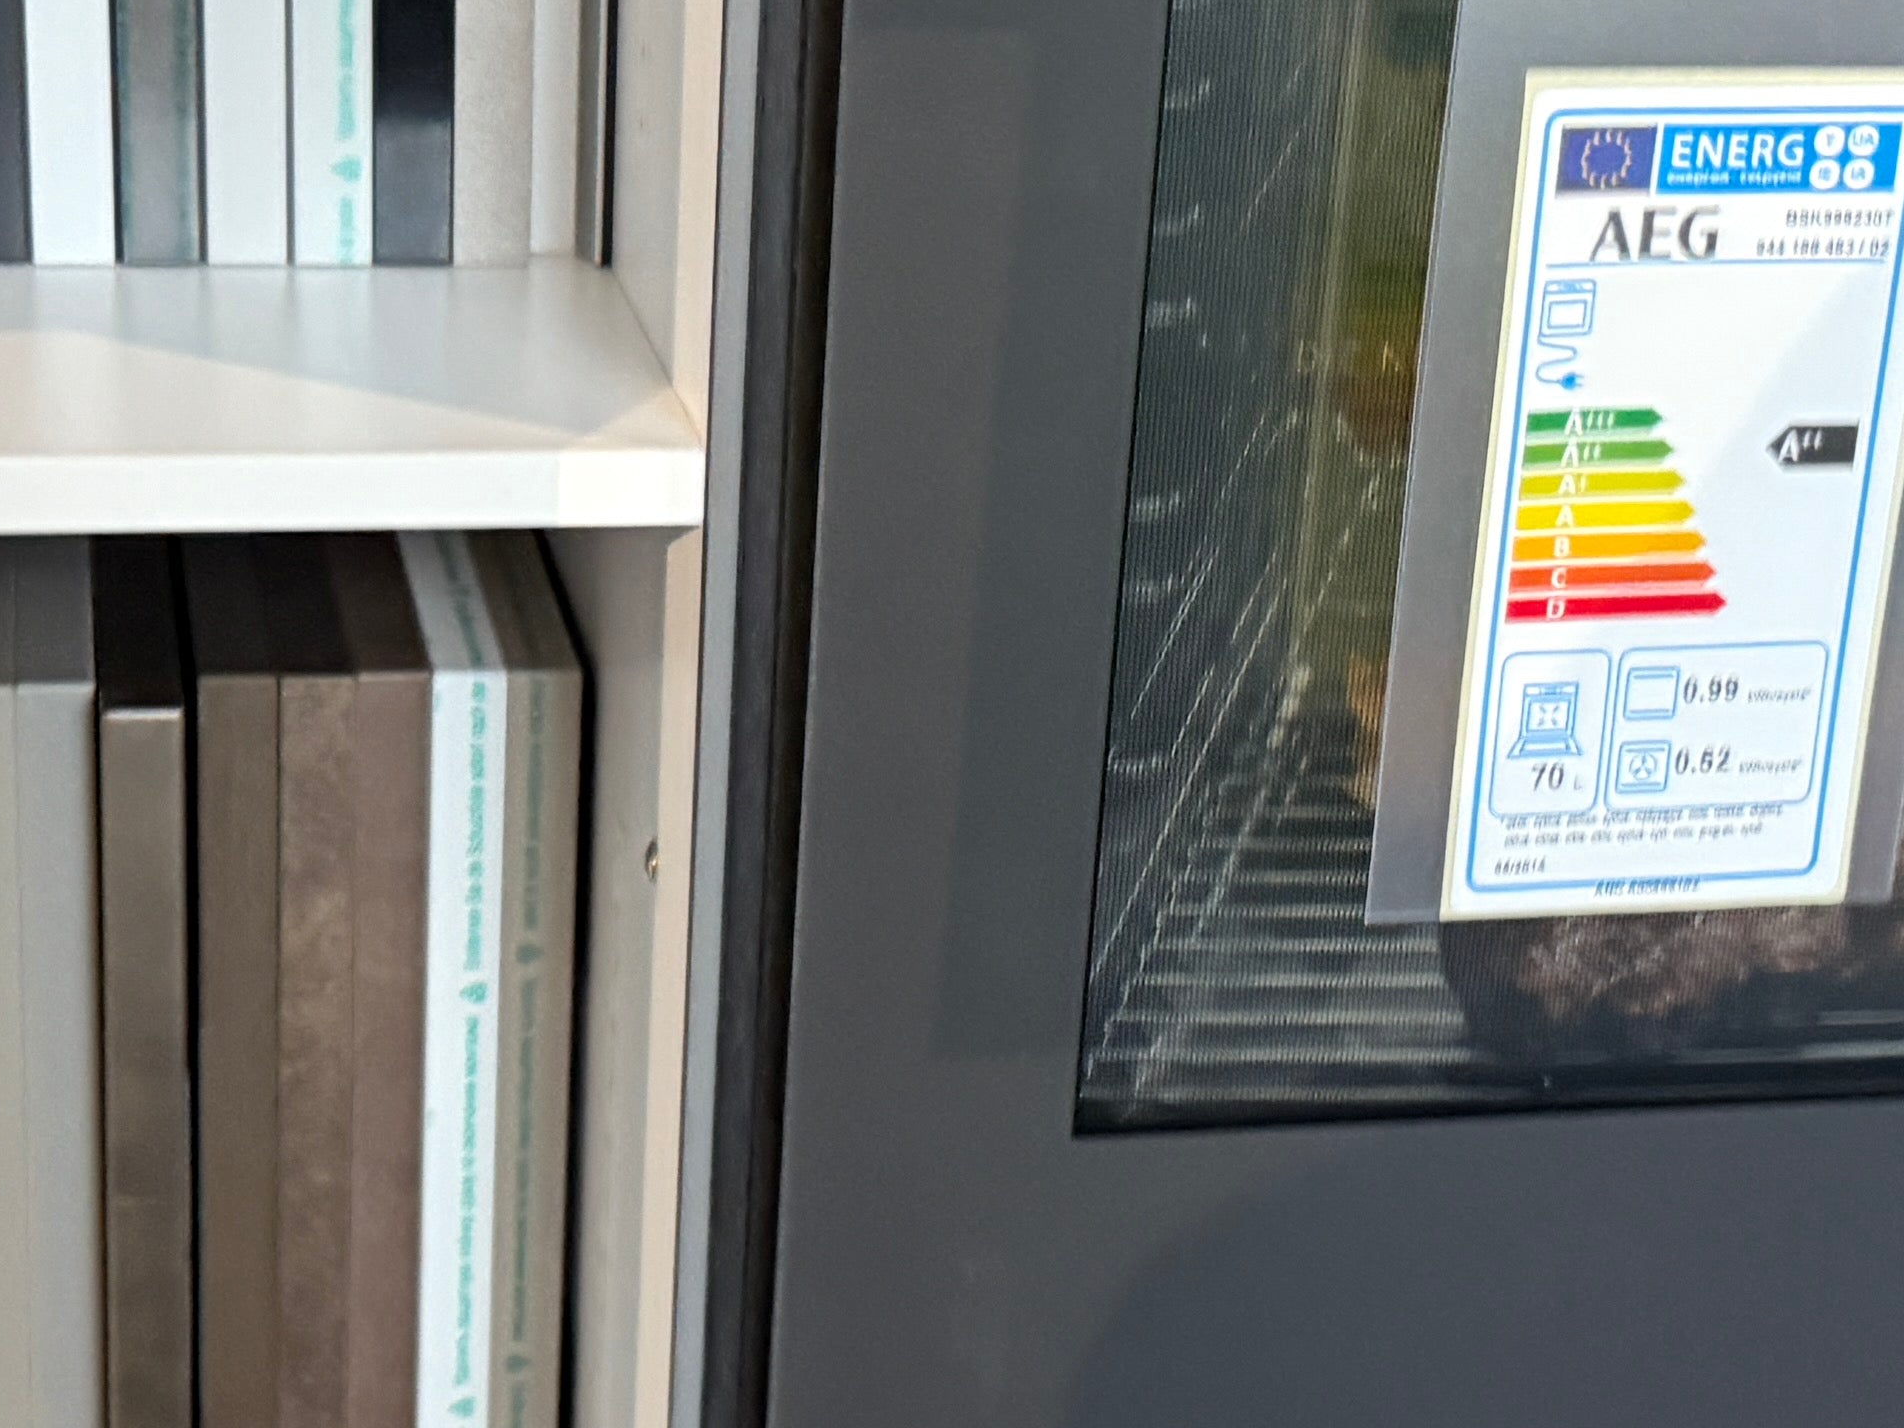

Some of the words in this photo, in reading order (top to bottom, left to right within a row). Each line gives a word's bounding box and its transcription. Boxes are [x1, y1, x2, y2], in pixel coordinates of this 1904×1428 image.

[1670, 130, 1805, 170] ENERG
[1589, 204, 1720, 263] AEG
[1553, 535, 1572, 558] B
[1550, 566, 1568, 590] C
[1545, 597, 1566, 621] D
[1682, 673, 1741, 705] 0.99
[1532, 761, 1566, 792] 70
